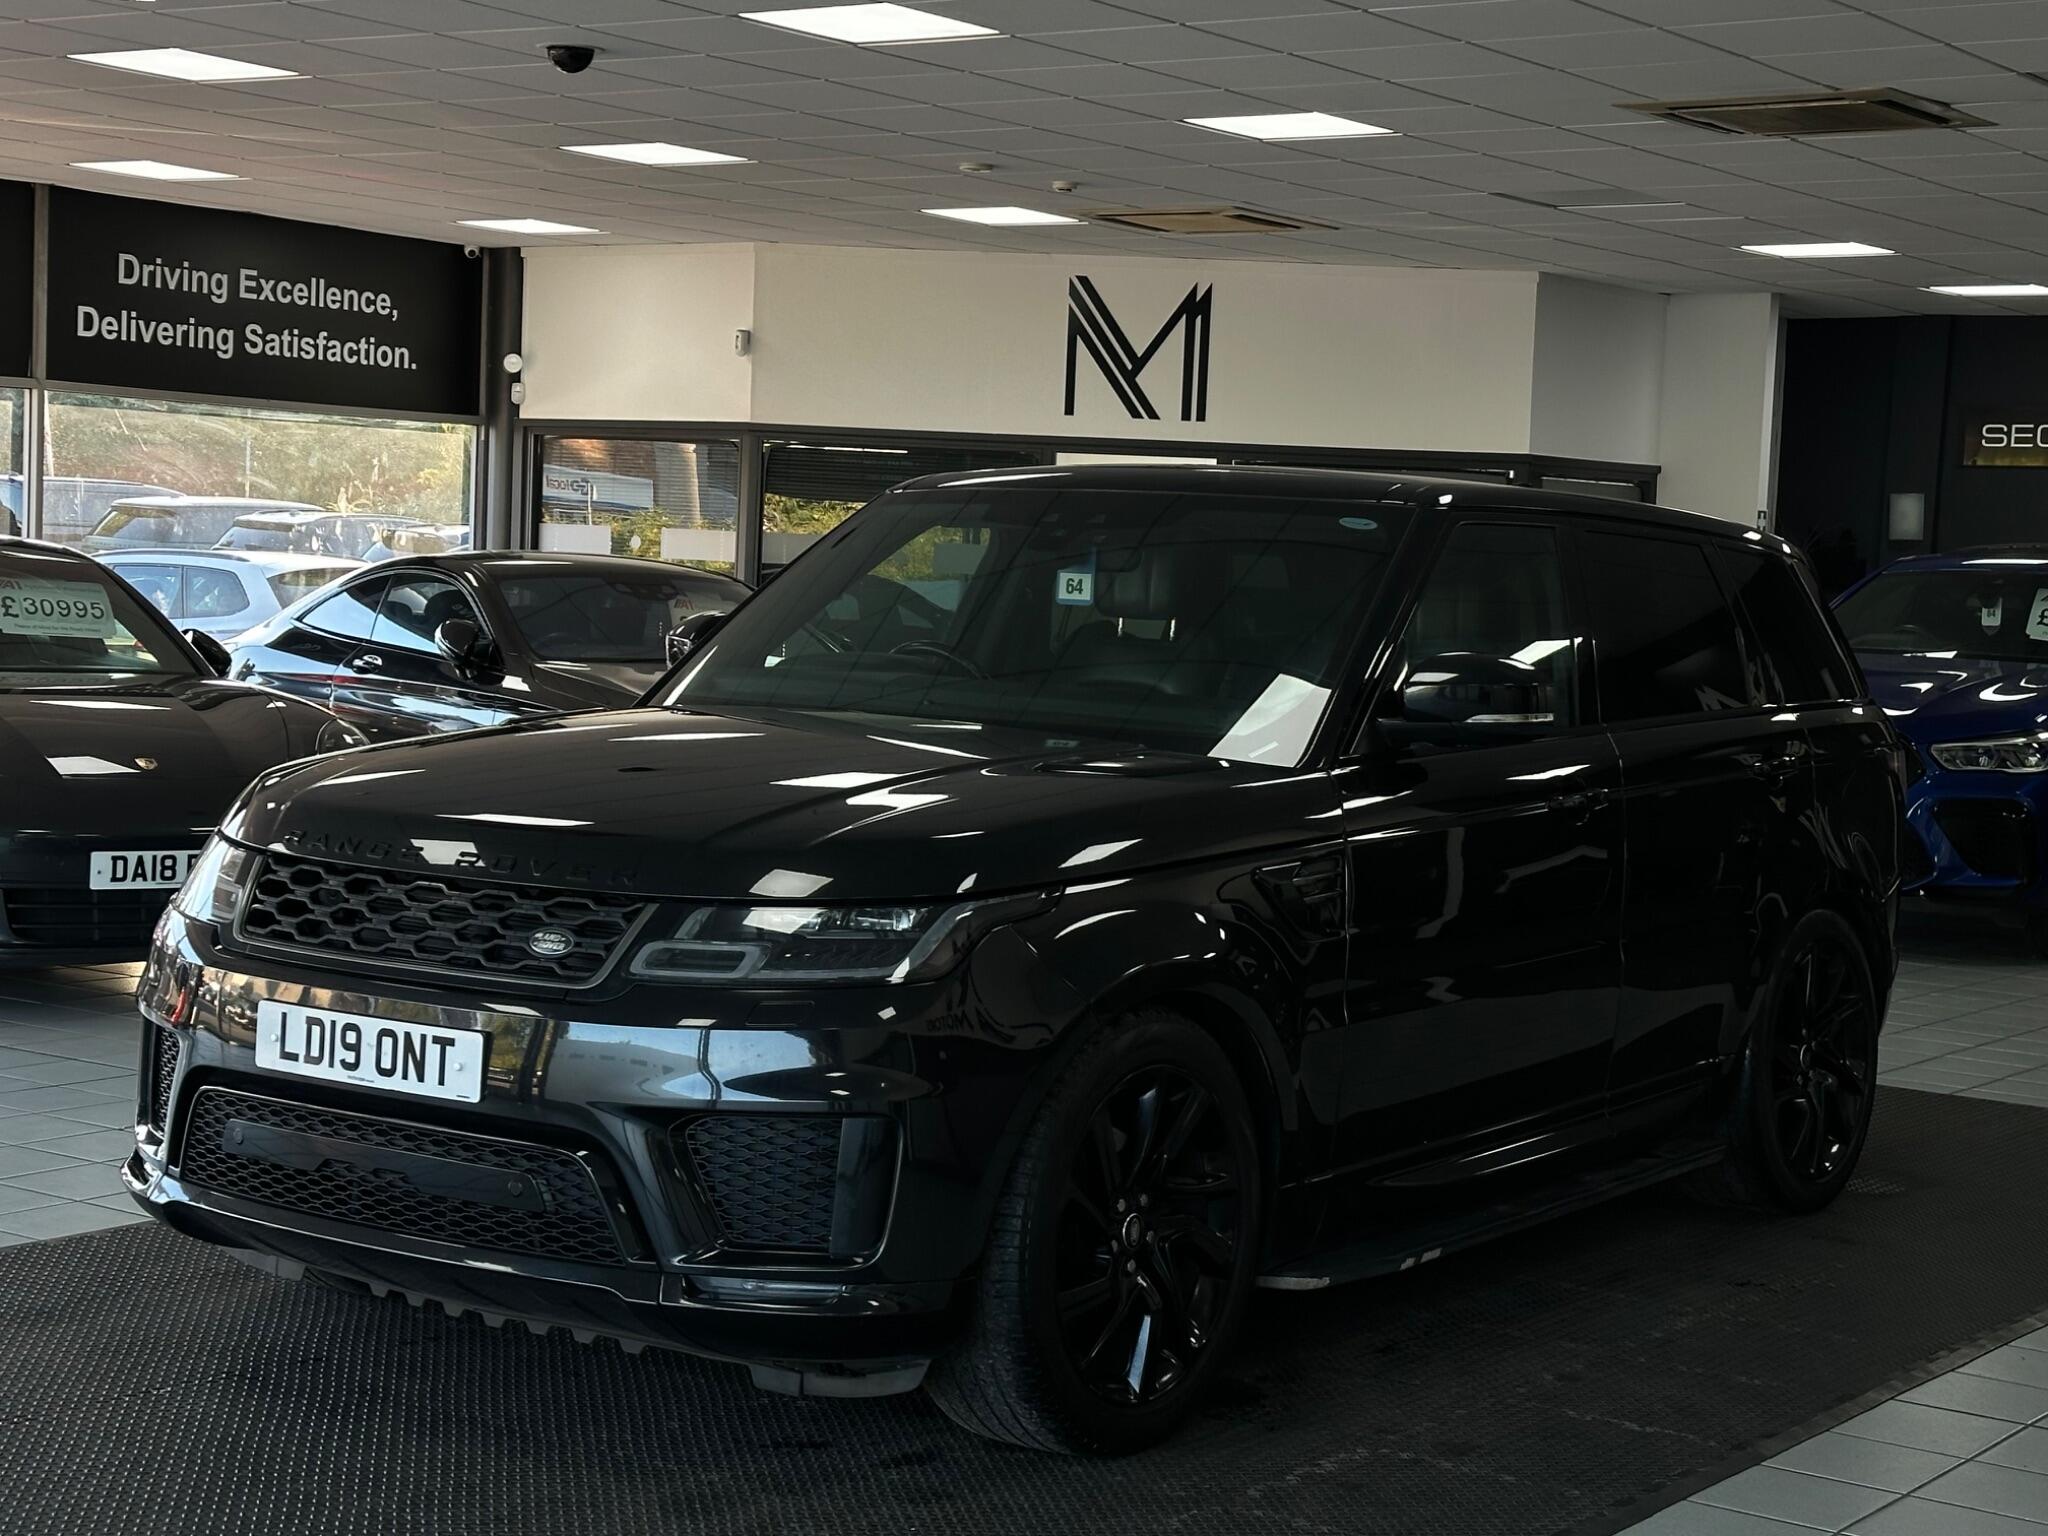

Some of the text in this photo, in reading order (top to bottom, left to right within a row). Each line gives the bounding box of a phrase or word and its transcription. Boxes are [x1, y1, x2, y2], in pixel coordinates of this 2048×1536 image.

[117, 252, 399, 321] Driving Excellence,
[76, 304, 417, 370] Delivering Satisfaction.
[1066, 577, 1084, 595] 64
[110, 854, 178, 883] DA18
[279, 1011, 362, 1072] LD19
